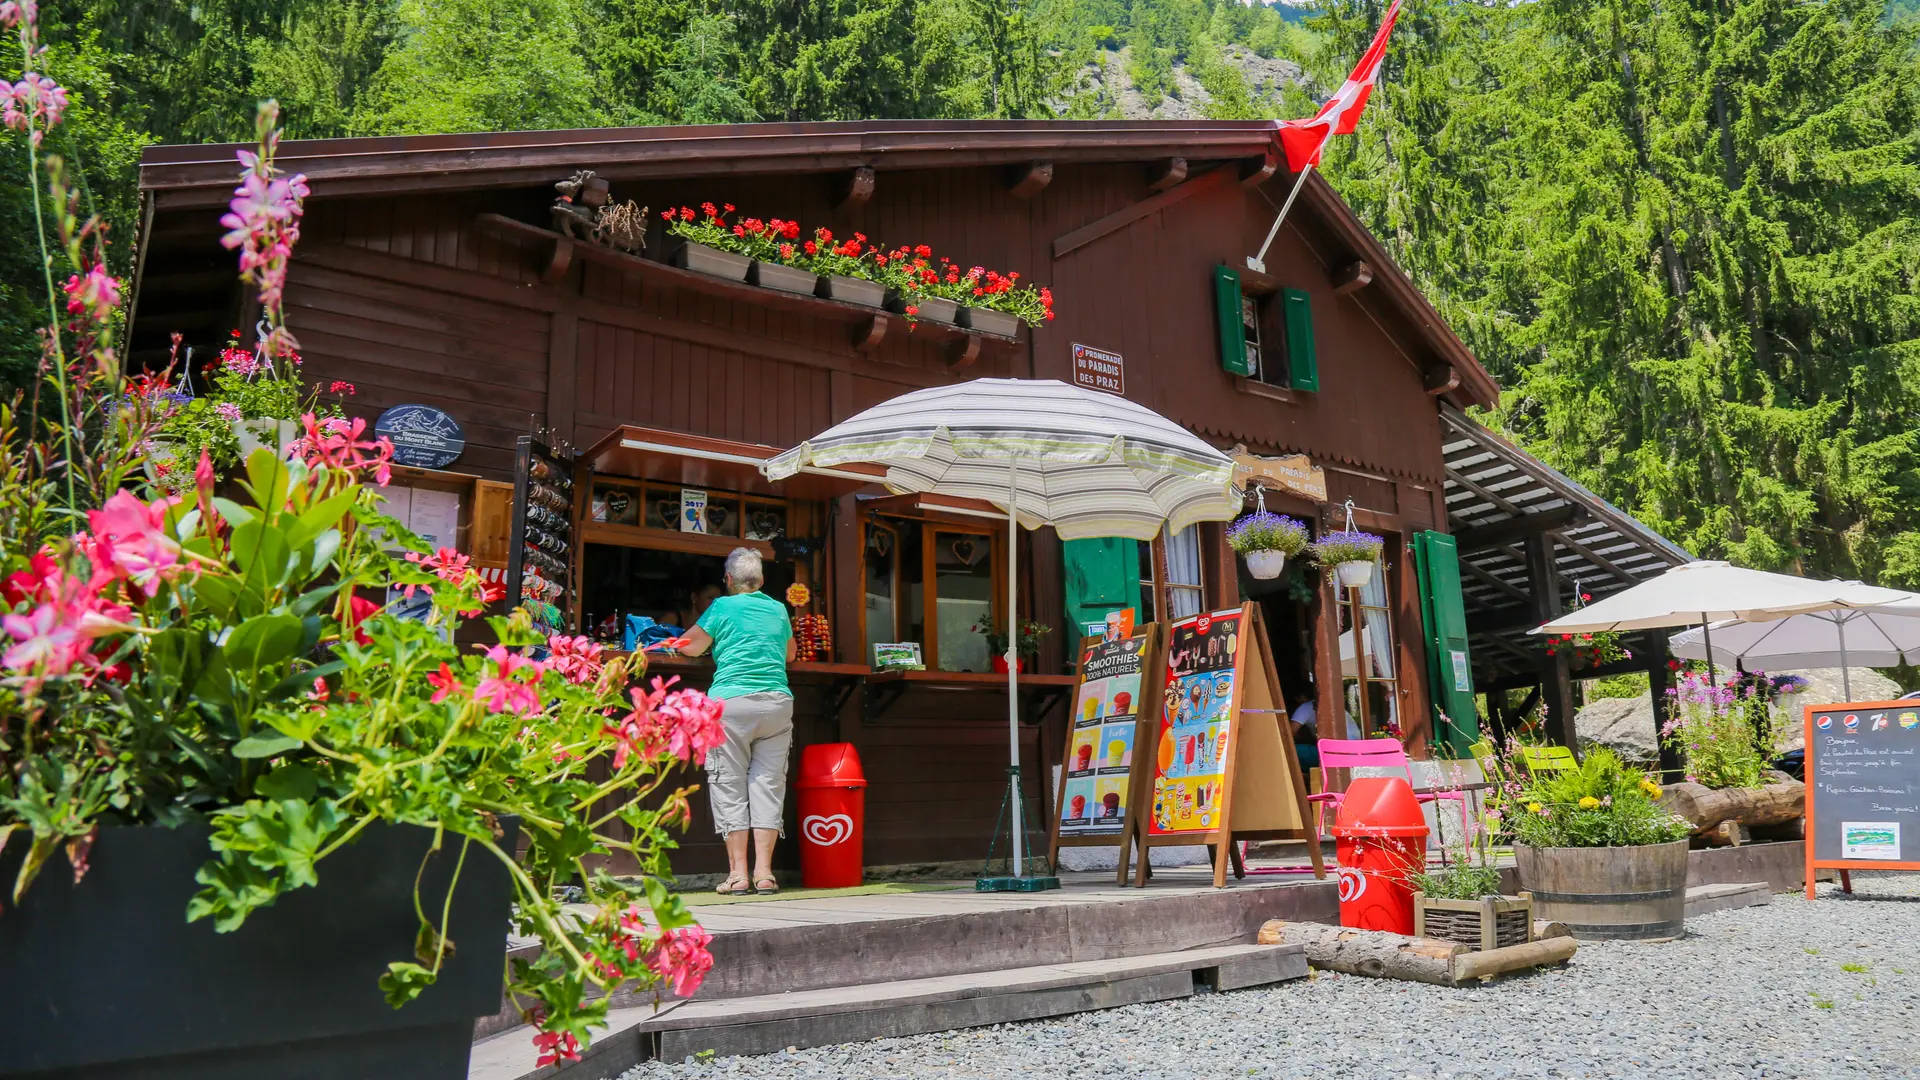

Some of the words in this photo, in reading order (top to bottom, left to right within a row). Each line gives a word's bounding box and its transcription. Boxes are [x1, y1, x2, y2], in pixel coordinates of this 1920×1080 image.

[1085, 349, 1121, 364] PROMENADE
[1078, 359, 1086, 368] DU
[1088, 360, 1119, 376] PARADIS
[1080, 373, 1093, 384] DES
[1096, 375, 1119, 390] PRAZ
[1263, 468, 1273, 476] DU
[1280, 466, 1310, 480] PARADIS
[1287, 480, 1300, 489] DES
[1304, 484, 1324, 496] PRAZ
[684, 500, 704, 509] 2017
[1087, 653, 1140, 672] SMOOTHIES
[1086, 670, 1101, 680] 100%
[1101, 663, 1139, 677] NATURELS
